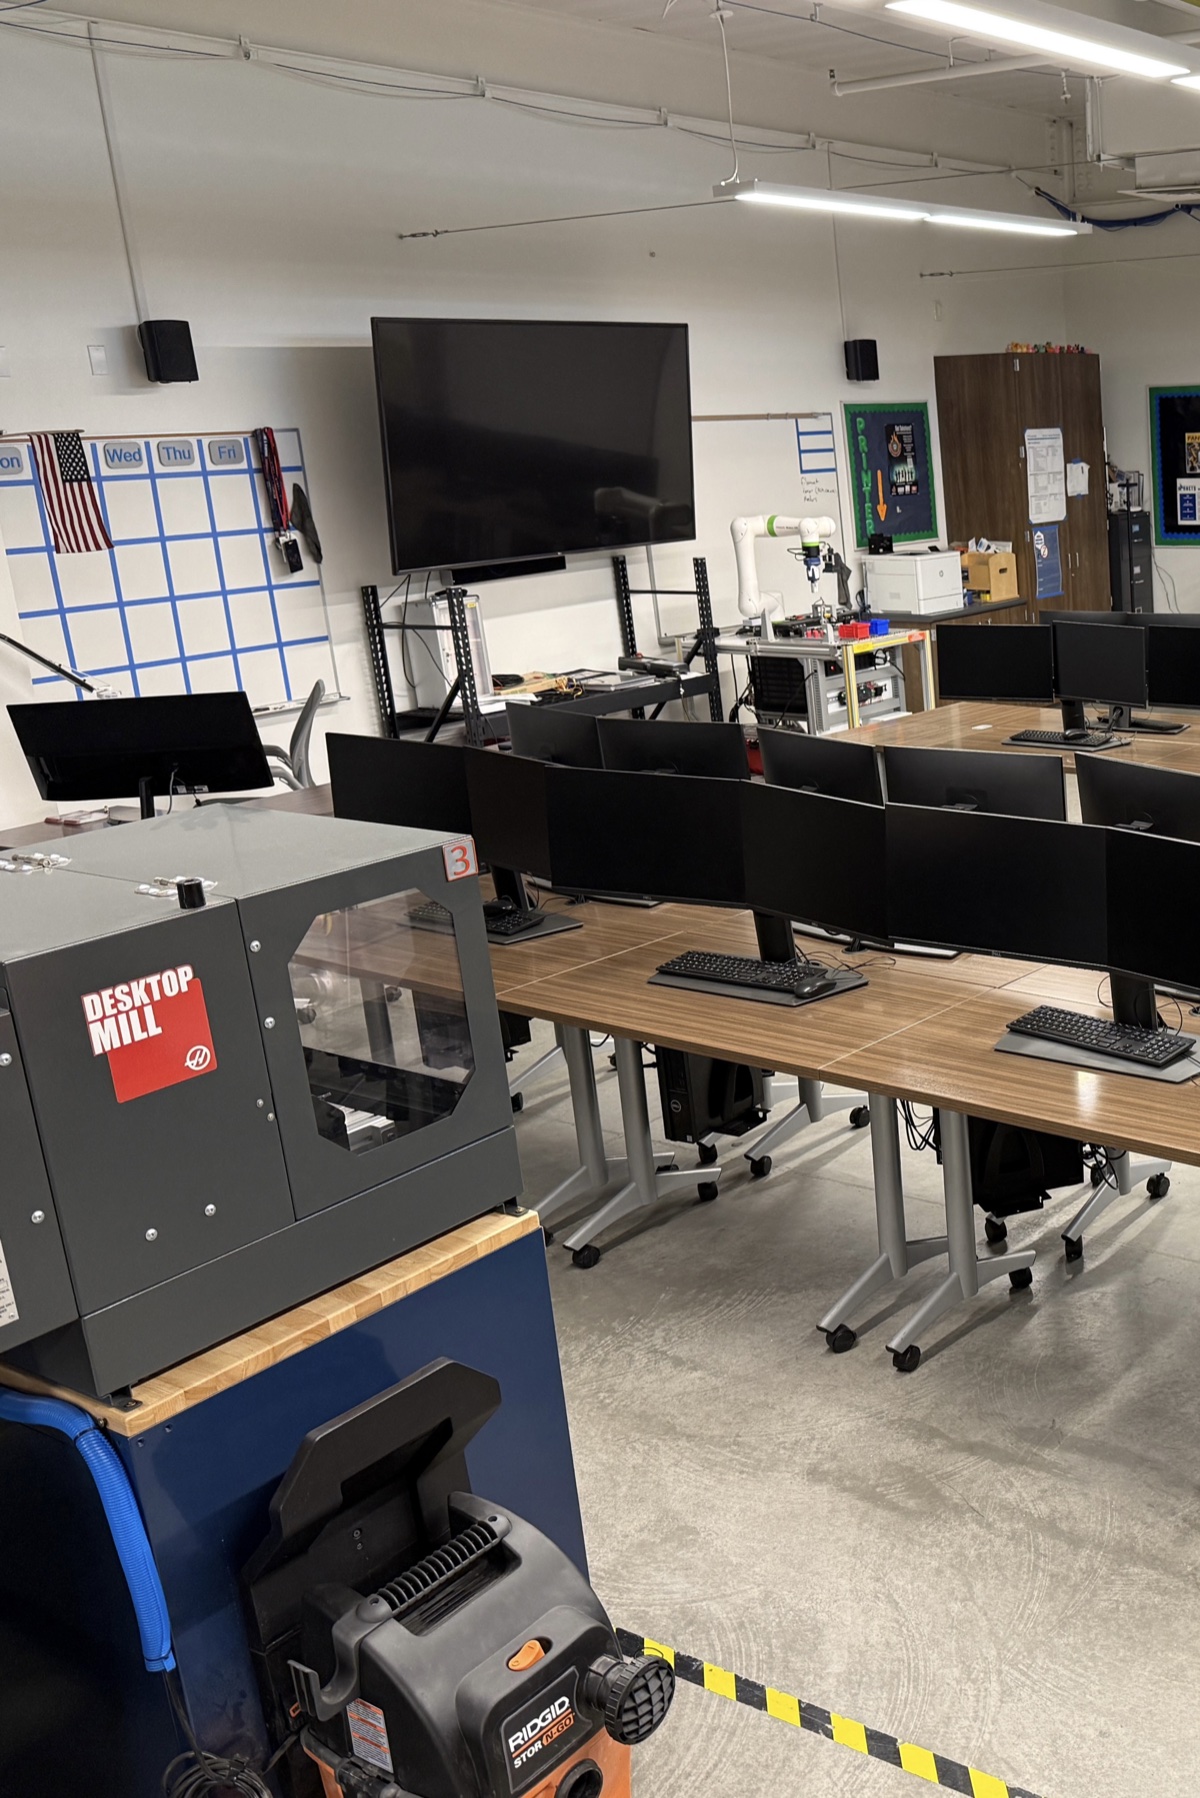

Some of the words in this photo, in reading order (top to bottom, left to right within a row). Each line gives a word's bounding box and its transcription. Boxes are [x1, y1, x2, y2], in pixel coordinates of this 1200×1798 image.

[0, 454, 21, 469] on
[106, 447, 143, 463] Wed
[161, 446, 192, 461] Thu
[217, 445, 237, 460] Fri
[451, 845, 471, 876] 3
[82, 965, 194, 1023] DESKTOP
[88, 1004, 163, 1056] MILL
[508, 1696, 570, 1753] RIDGID
[513, 1739, 543, 1769] STOR
[545, 1715, 572, 1744] N-GO
